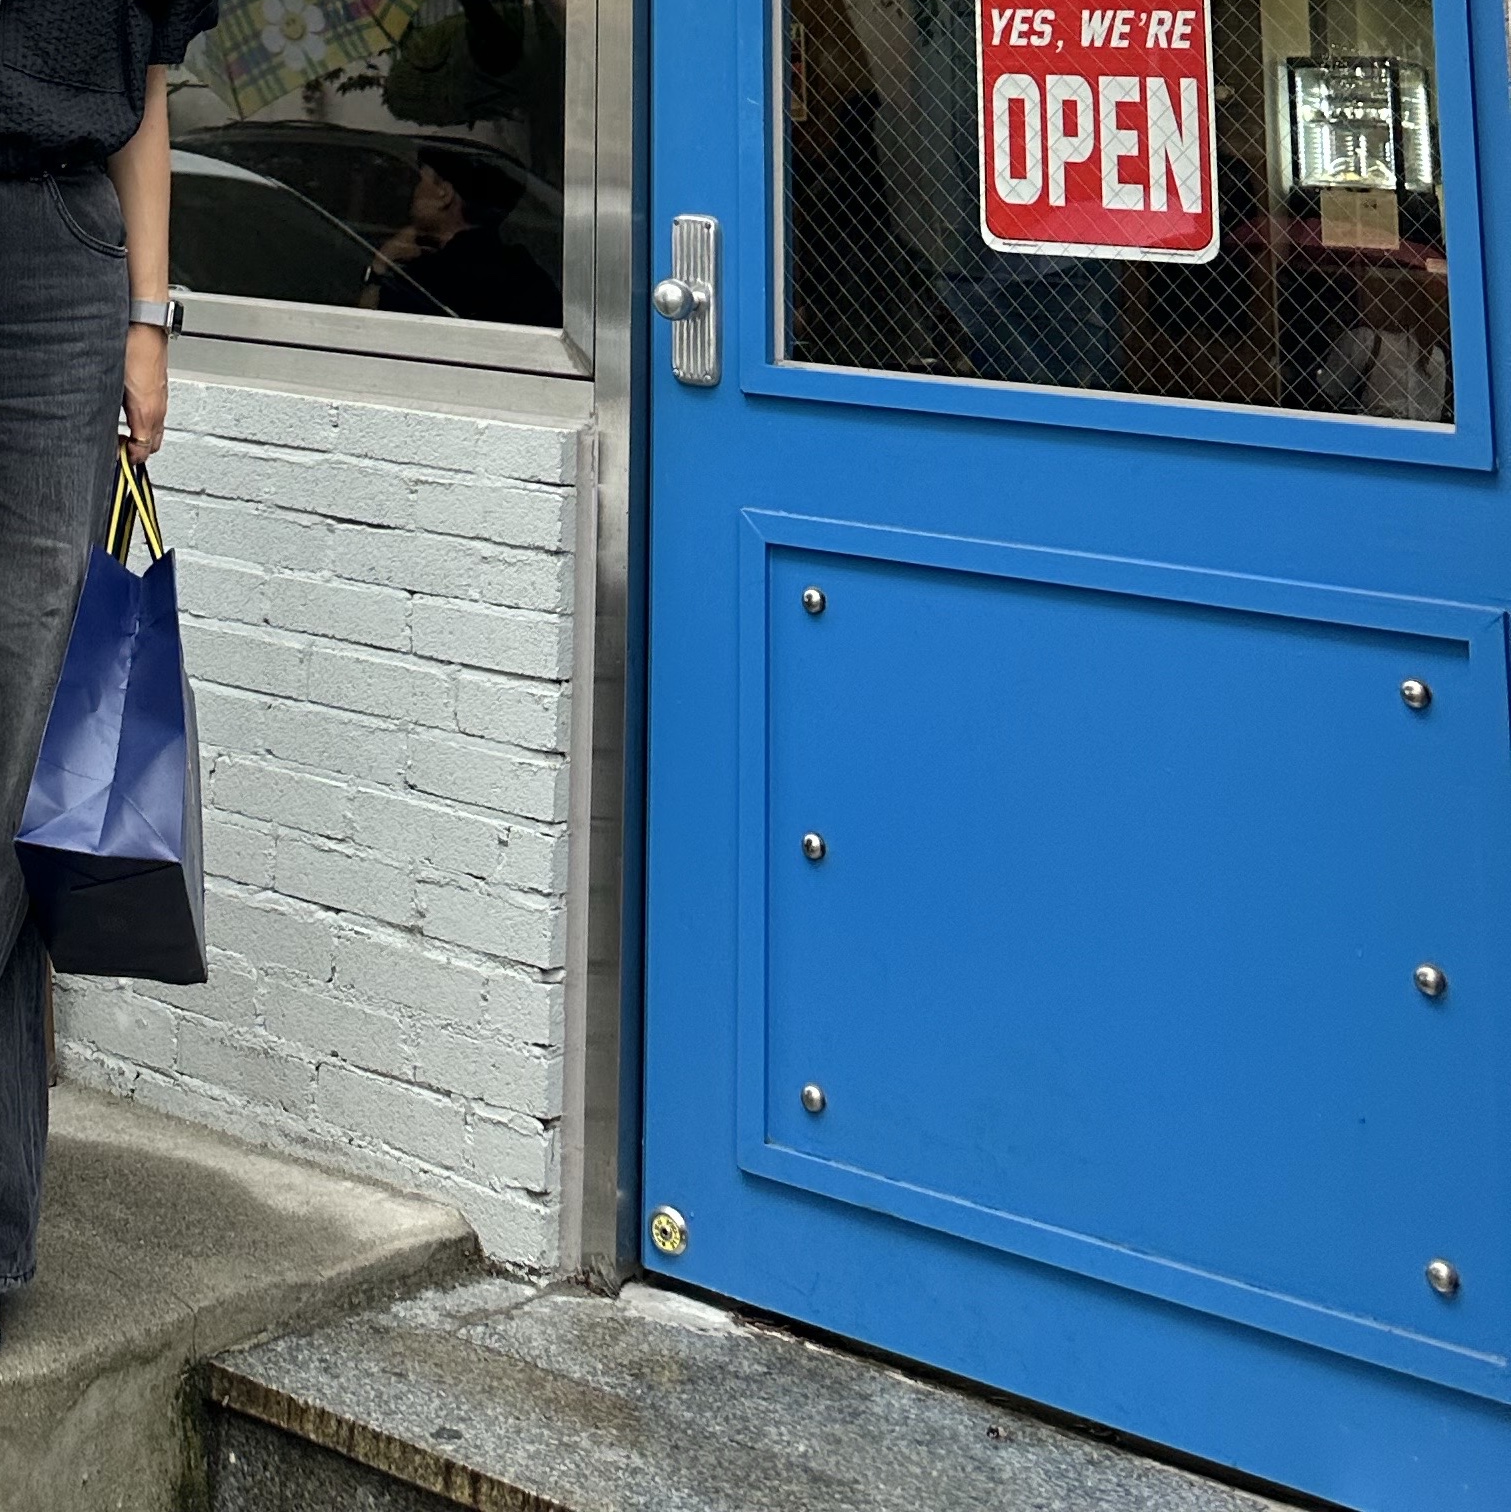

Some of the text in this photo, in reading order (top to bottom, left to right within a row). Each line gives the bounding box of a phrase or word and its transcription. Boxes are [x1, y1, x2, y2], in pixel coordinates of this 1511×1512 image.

[990, 8, 1197, 54] YES, WE'RE
[992, 72, 1203, 215] OPEN
